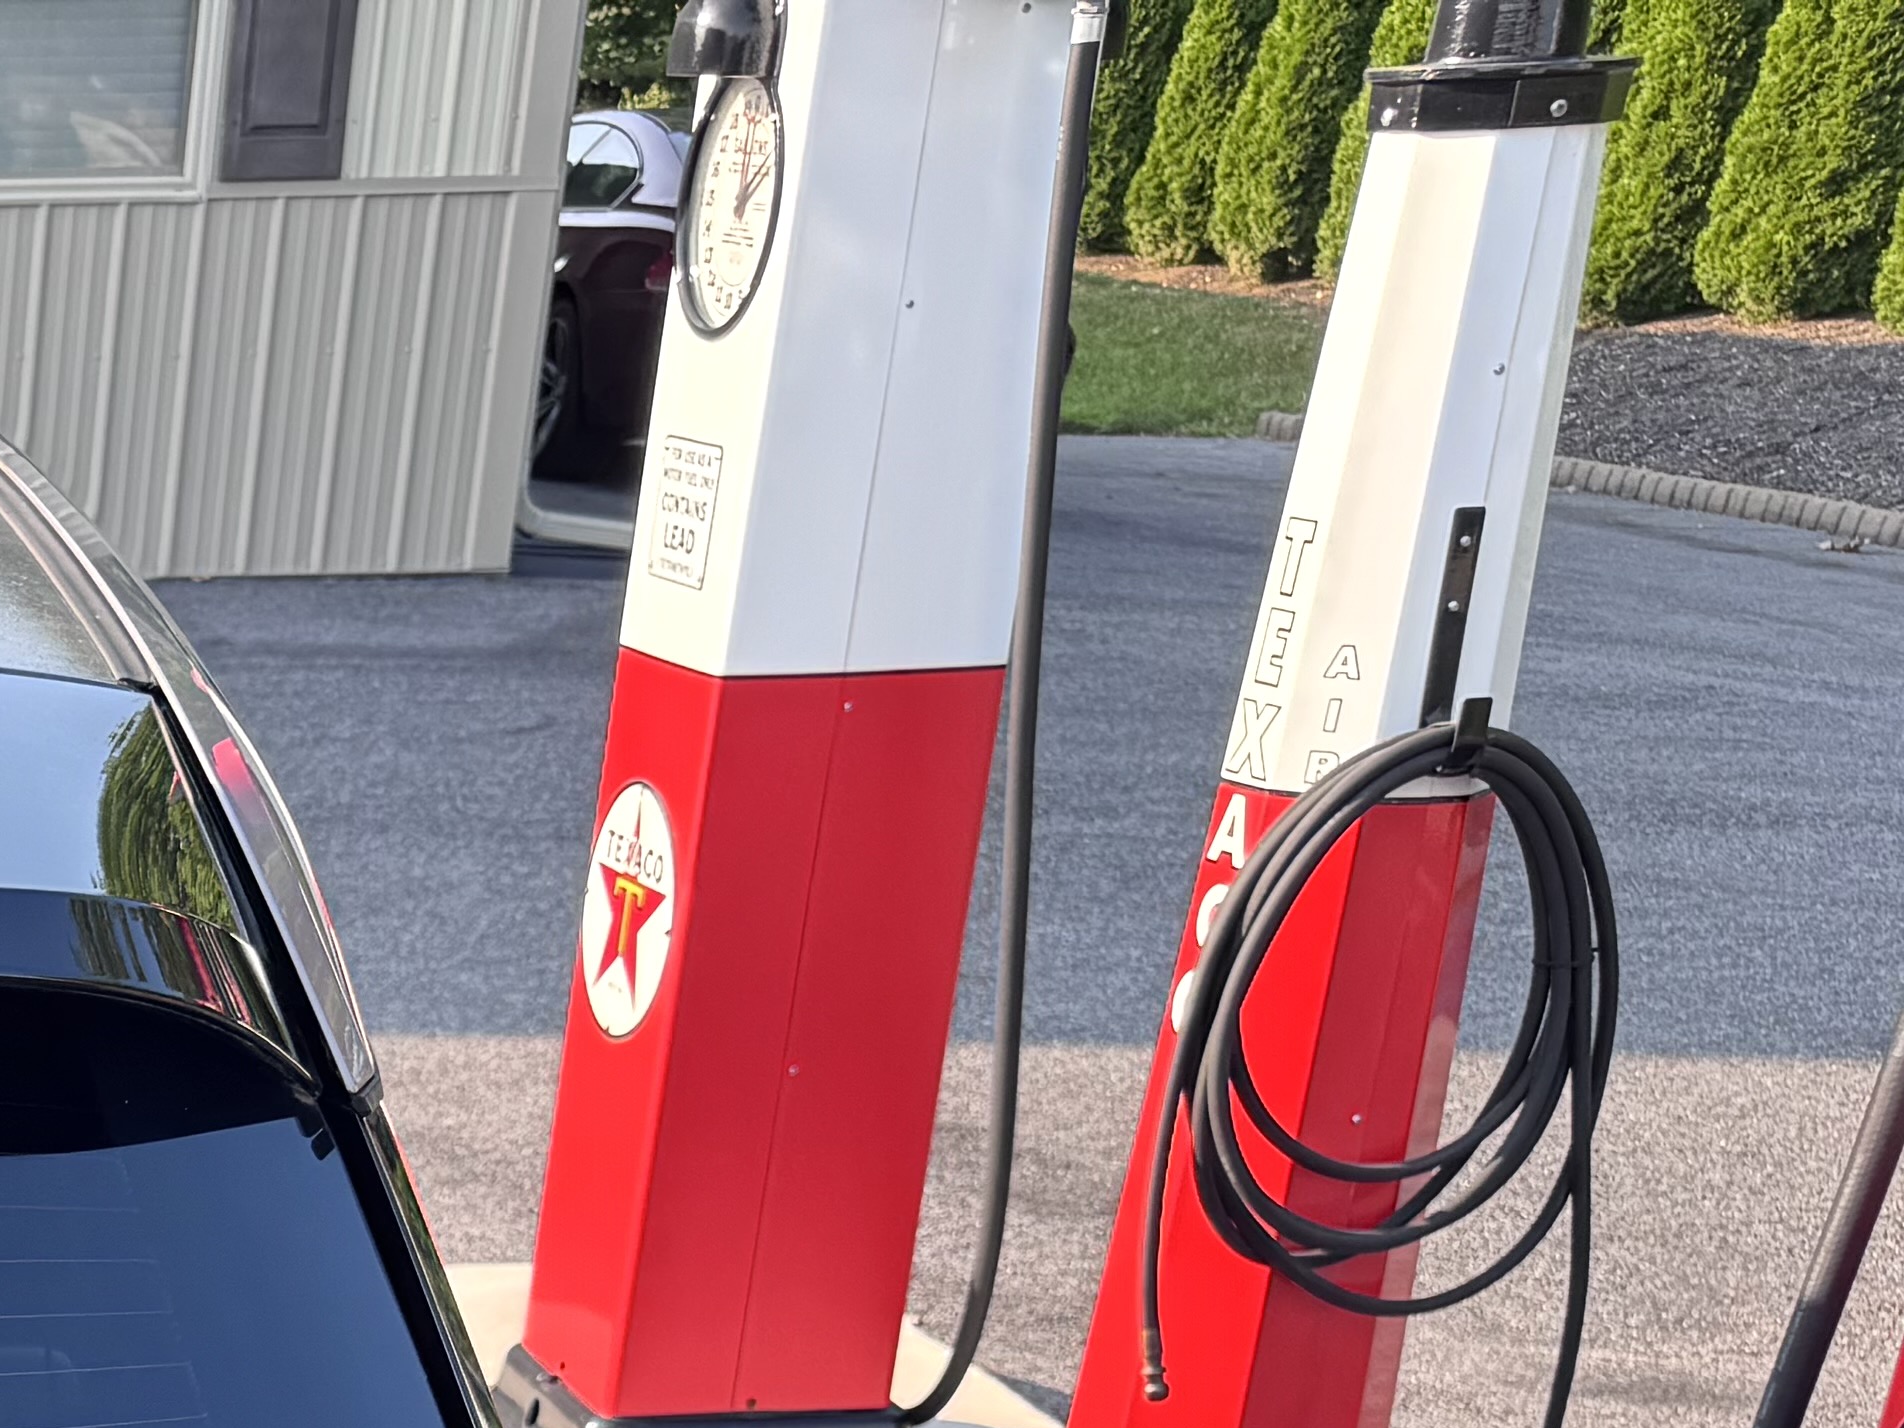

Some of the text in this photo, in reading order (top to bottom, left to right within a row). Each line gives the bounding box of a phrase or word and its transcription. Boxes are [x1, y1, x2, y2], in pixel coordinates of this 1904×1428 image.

[663, 521, 696, 555] LEAD
[1303, 644, 1361, 785] AIR
[606, 829, 665, 884] TEXACO
[613, 876, 647, 959] T
